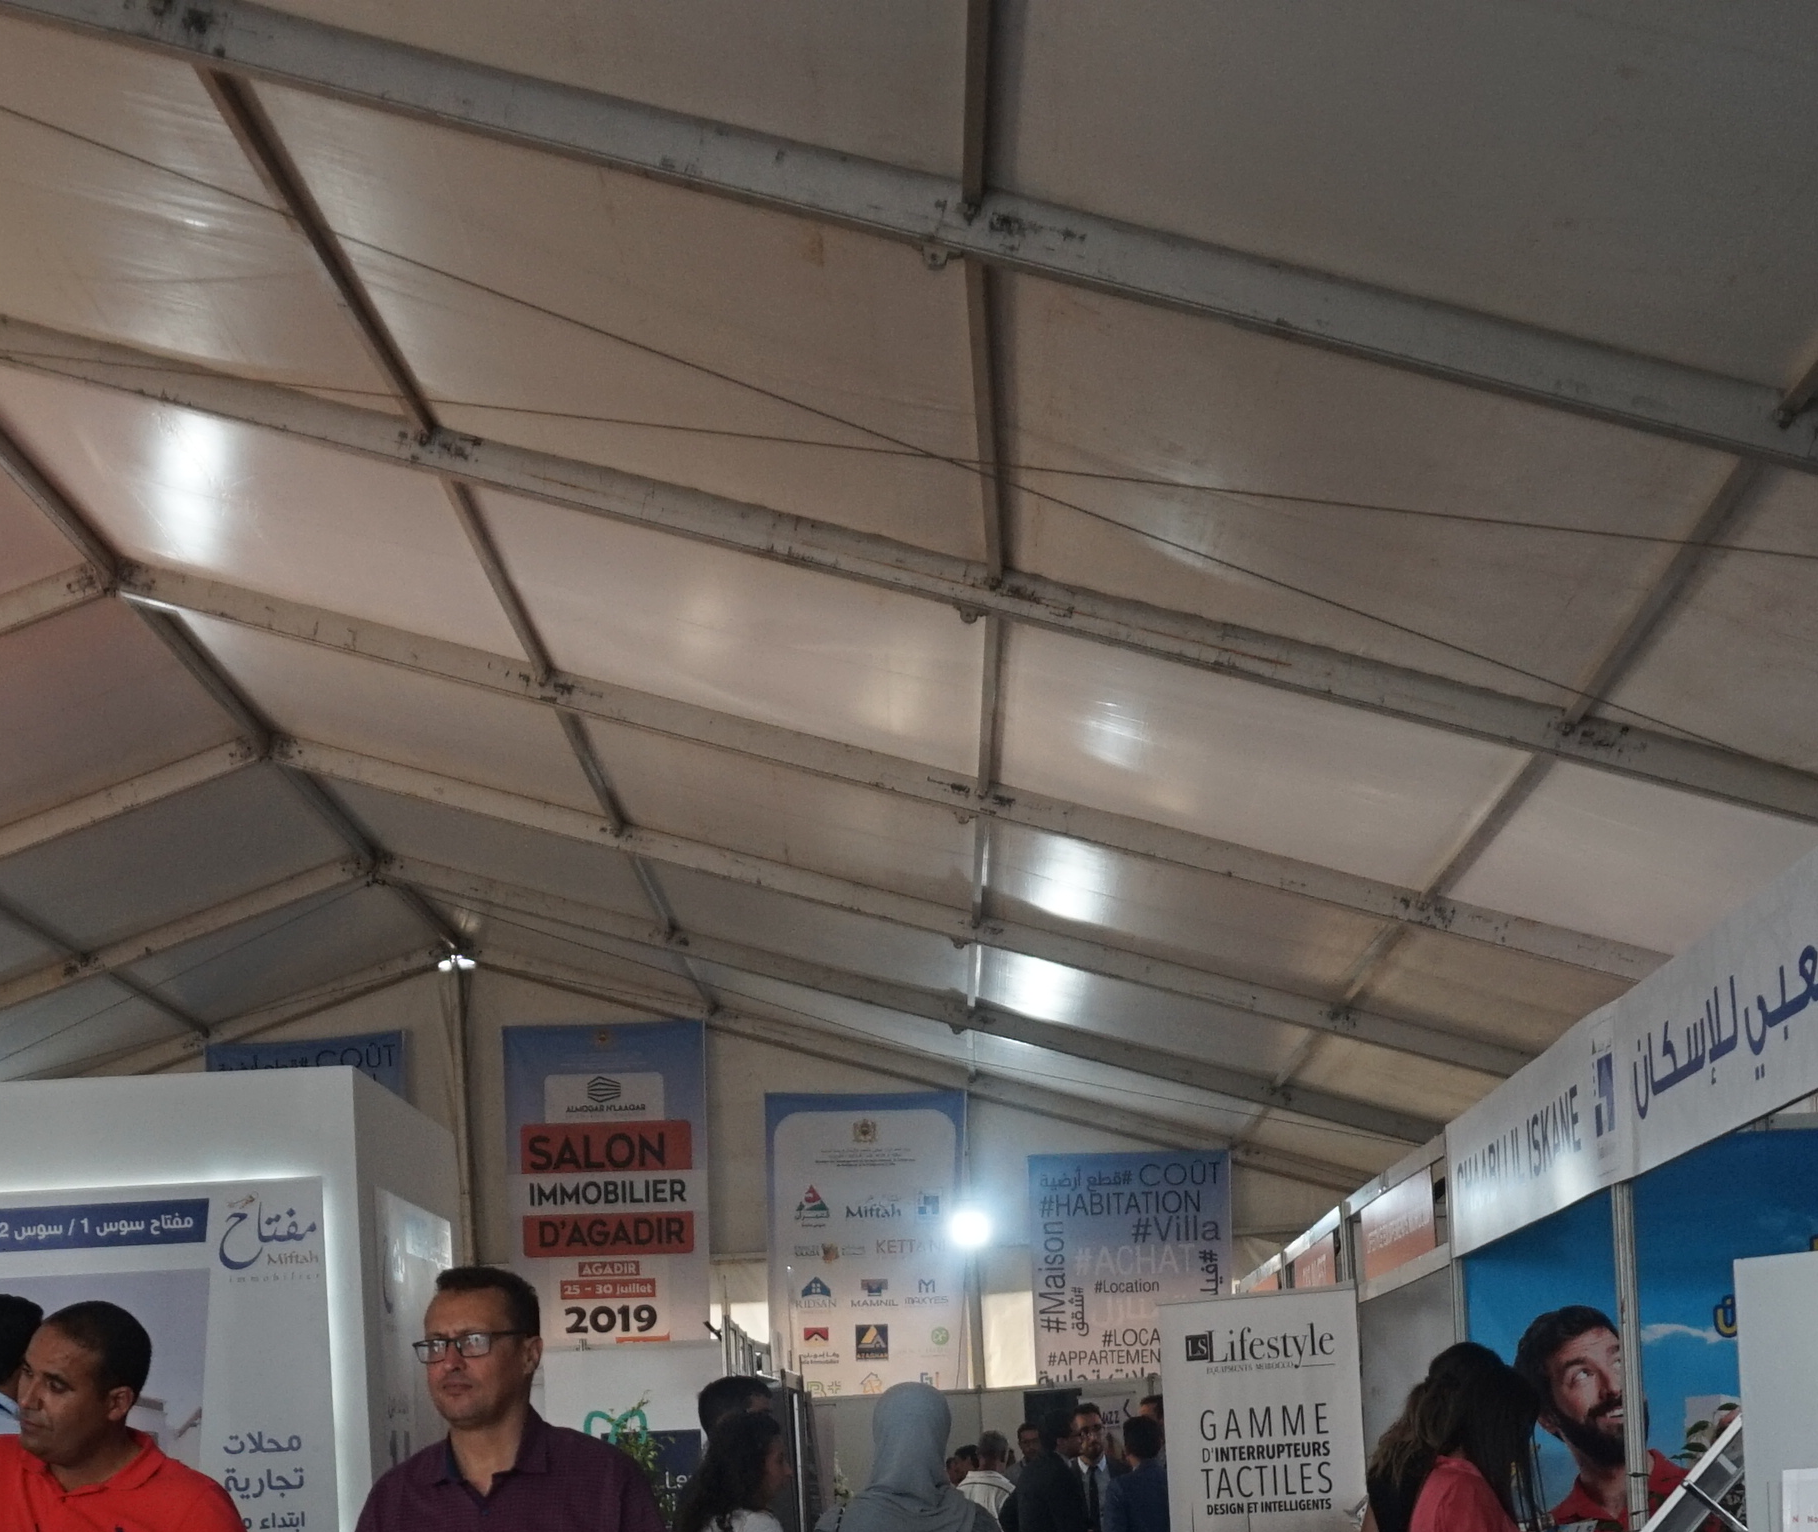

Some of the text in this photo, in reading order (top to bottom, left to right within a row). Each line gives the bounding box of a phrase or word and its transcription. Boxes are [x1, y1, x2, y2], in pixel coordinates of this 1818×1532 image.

[1632, 976, 1738, 1119] للإسكان
[1527, 1084, 1582, 1180] ISKANE
[529, 1131, 666, 1170] SALON
[1139, 1159, 1221, 1187] COÛT
[529, 1179, 686, 1206] IMMOBILIER
[1039, 1190, 1201, 1218] #HABITATION
[845, 1203, 902, 1219] Miftah
[14, 1221, 63, 1240] سوس
[81, 1218, 90, 1234] 1
[96, 1218, 145, 1237] سوس
[150, 1214, 194, 1237] مفتاح
[218, 1199, 318, 1271] مفتاح
[538, 1217, 685, 1247] D'AGADIR
[1132, 1215, 1222, 1243] #Villa
[267, 1250, 320, 1266] Miftah
[582, 1262, 637, 1275] AGADIR
[564, 1284, 580, 1294] 25
[595, 1283, 613, 1294] 30
[616, 1282, 653, 1295] juillet
[1038, 1221, 1067, 1334] #Maison
[1094, 1279, 1160, 1294] #Location
[564, 1304, 657, 1334] 2019
[1102, 1328, 1161, 1348] #LOCA
[1206, 1322, 1335, 1368] Lifestyle
[1048, 1348, 1161, 1367] #APPARTEMEN
[1200, 1402, 1329, 1441] GAMME
[223, 1430, 303, 1455] محلات
[1202, 1441, 1331, 1463] D'INTERRUPTEURS
[224, 1466, 305, 1499] تجارية
[1200, 1461, 1333, 1499] TACTILES
[1207, 1498, 1332, 1516] DESIGN ET INTELLIGENTS
[259, 1511, 306, 1532] ابتداء
